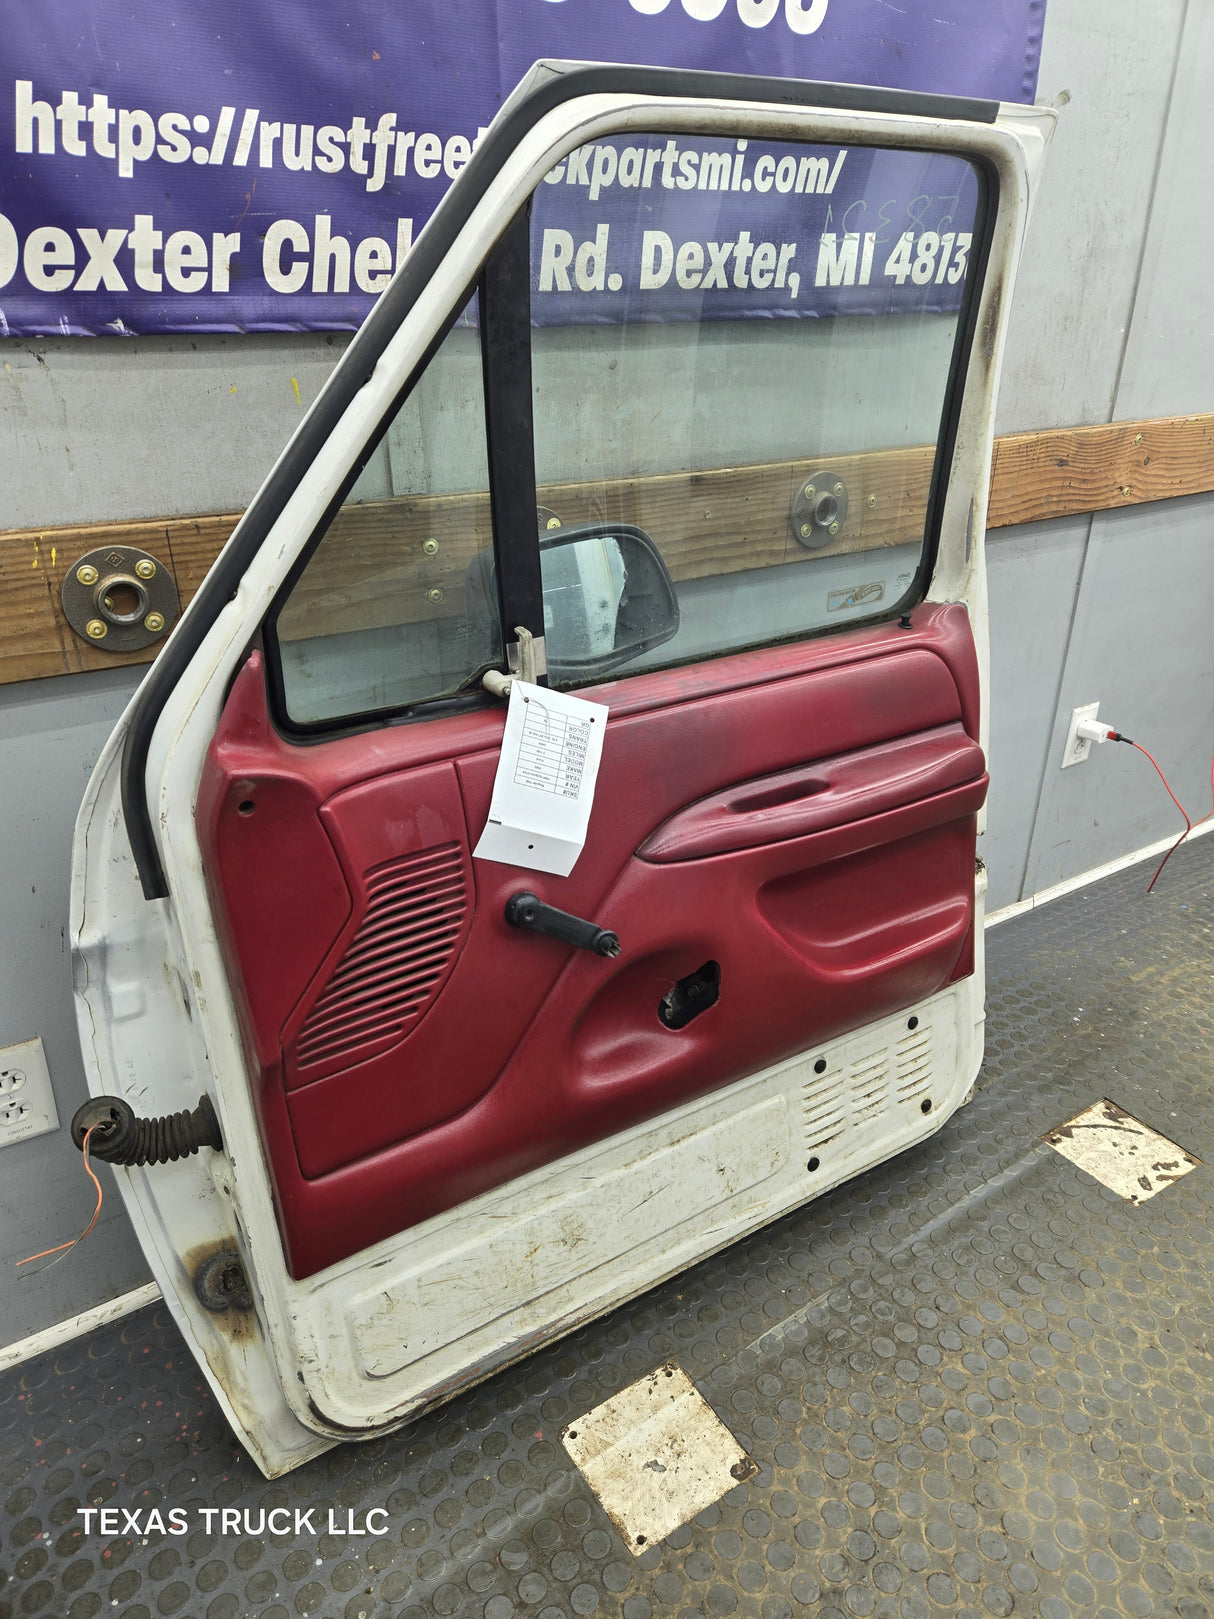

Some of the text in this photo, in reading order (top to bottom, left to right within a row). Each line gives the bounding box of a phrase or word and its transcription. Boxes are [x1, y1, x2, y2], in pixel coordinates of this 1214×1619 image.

[539, 224, 623, 292] Rd.
[640, 230, 800, 299] Dexter,
[816, 233, 876, 288] MI
[885, 232, 973, 286] 4813
[568, 726, 588, 736] COLOR
[568, 734, 586, 744] TRANS
[565, 741, 585, 751] ENGINE
[568, 750, 584, 759] MILES
[563, 757, 583, 766] MODEL
[566, 766, 581, 774] MAKE
[565, 774, 580, 782] YEAR
